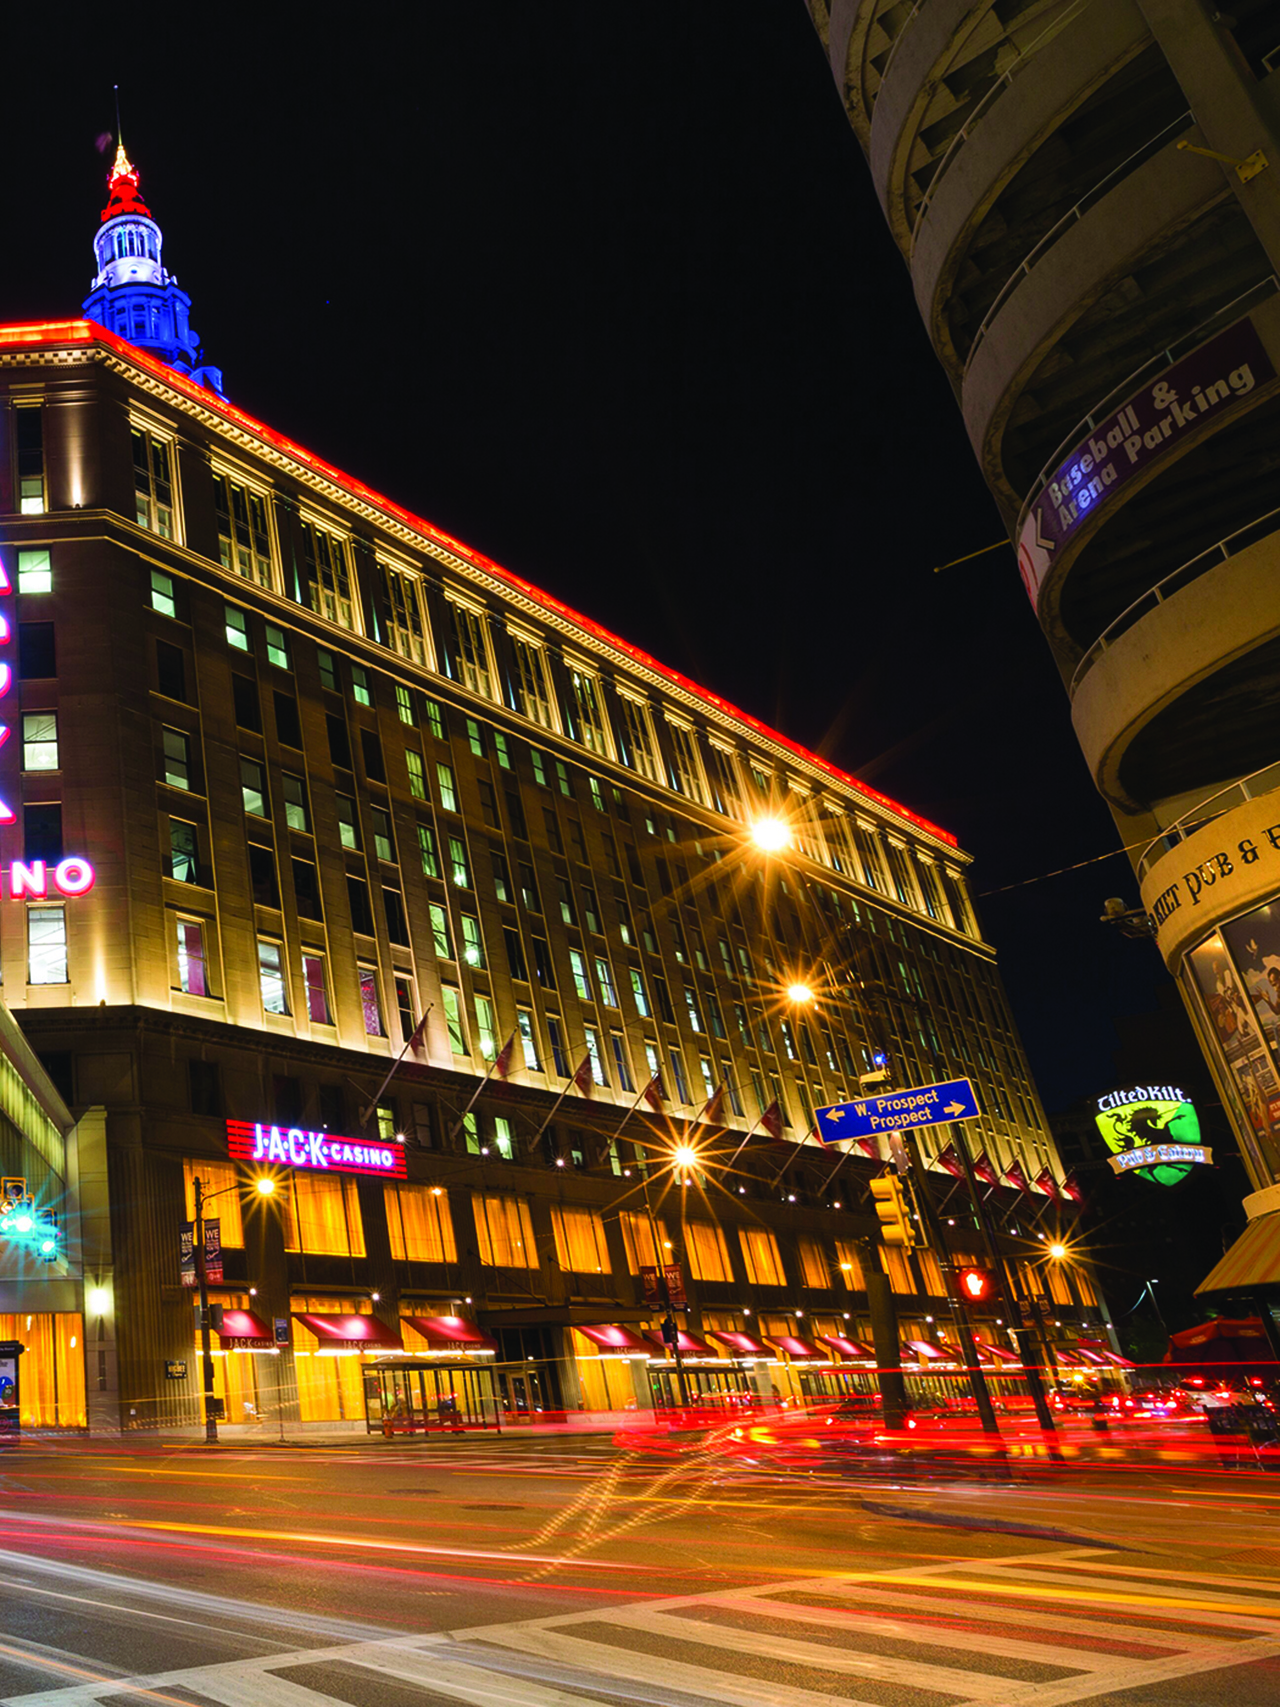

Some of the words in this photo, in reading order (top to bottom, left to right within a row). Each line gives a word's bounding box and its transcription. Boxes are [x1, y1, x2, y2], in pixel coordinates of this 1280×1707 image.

[1048, 405, 1141, 509] Baseball
[1152, 381, 1180, 410] &
[1057, 462, 1118, 532] Arena
[1123, 363, 1256, 464] Parking
[1182, 852, 1234, 906] PUB
[1238, 839, 1260, 864] &
[854, 1103, 871, 1117] W.
[877, 1090, 939, 1112] Prospect
[870, 1107, 933, 1129] Prospect
[253, 1124, 328, 1166] JACK
[330, 1143, 394, 1167] CASINO
[229, 1338, 253, 1349] JACK
